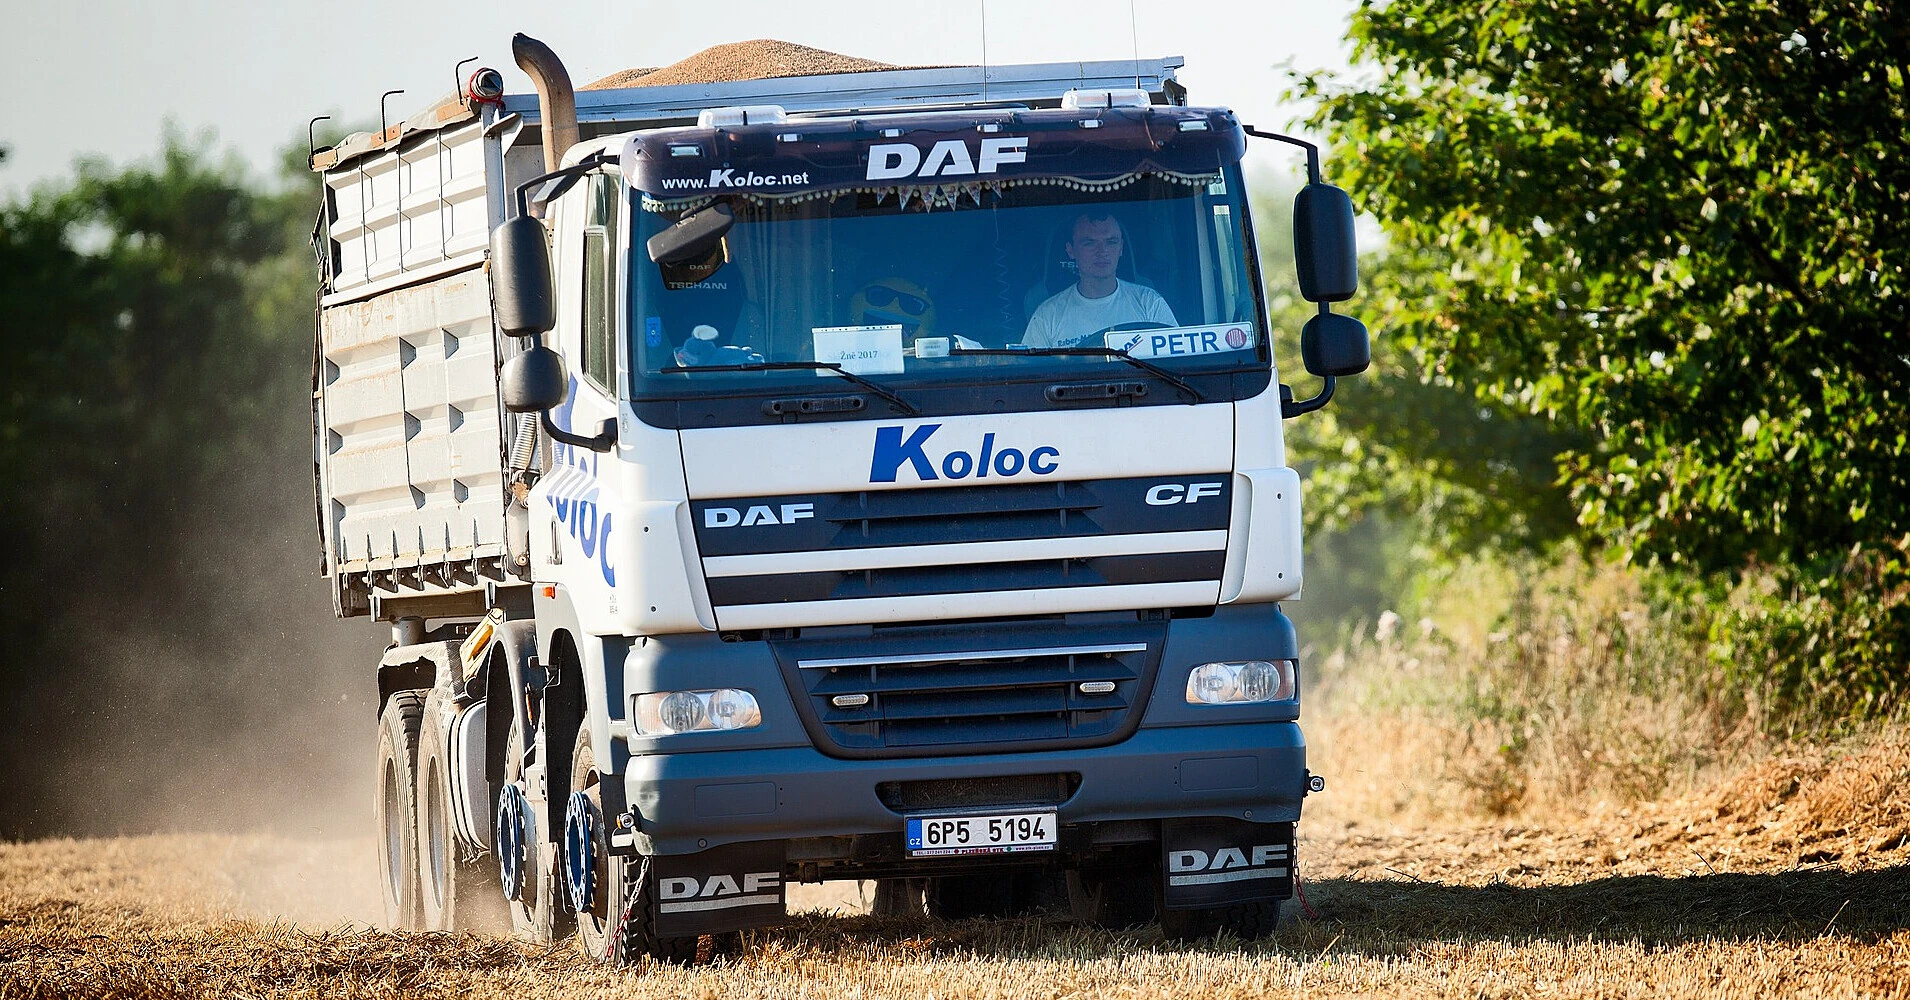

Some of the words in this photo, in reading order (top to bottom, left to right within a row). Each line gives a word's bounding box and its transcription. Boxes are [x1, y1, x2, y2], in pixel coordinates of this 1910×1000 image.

[866, 136, 1029, 180] DAF
[661, 168, 809, 190] www.Koloc.net
[858, 350, 878, 360] 2017
[1151, 331, 1220, 356] PETR
[868, 423, 1060, 483] Koloc
[1144, 482, 1223, 505] CF
[704, 502, 814, 529] DAF
[909, 838, 921, 846] CZ
[927, 820, 970, 845] 6P5
[988, 816, 1046, 842] 5194
[1169, 843, 1287, 873] DAF
[660, 871, 780, 900] DAF
